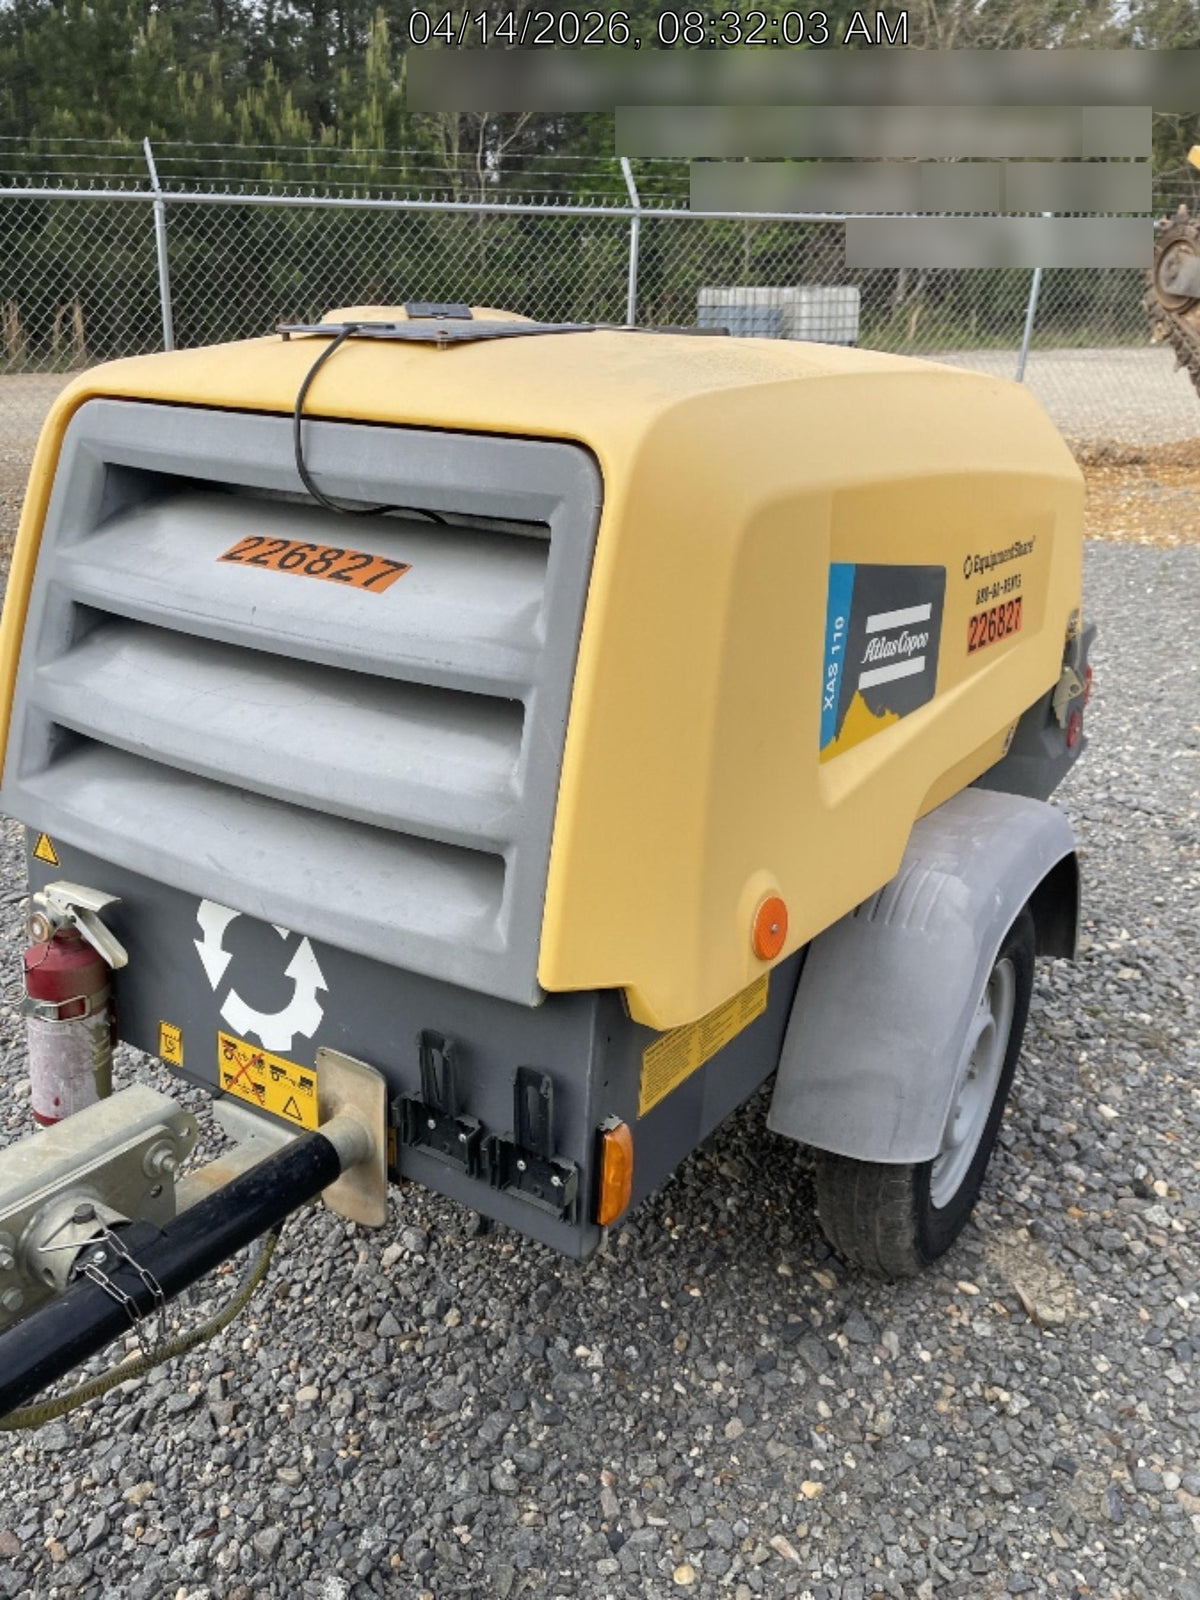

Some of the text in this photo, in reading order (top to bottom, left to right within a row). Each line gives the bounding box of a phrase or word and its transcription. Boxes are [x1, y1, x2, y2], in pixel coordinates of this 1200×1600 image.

[222, 536, 408, 588] 226827
[967, 596, 1023, 653] 226827
[823, 662, 839, 712] XAS
